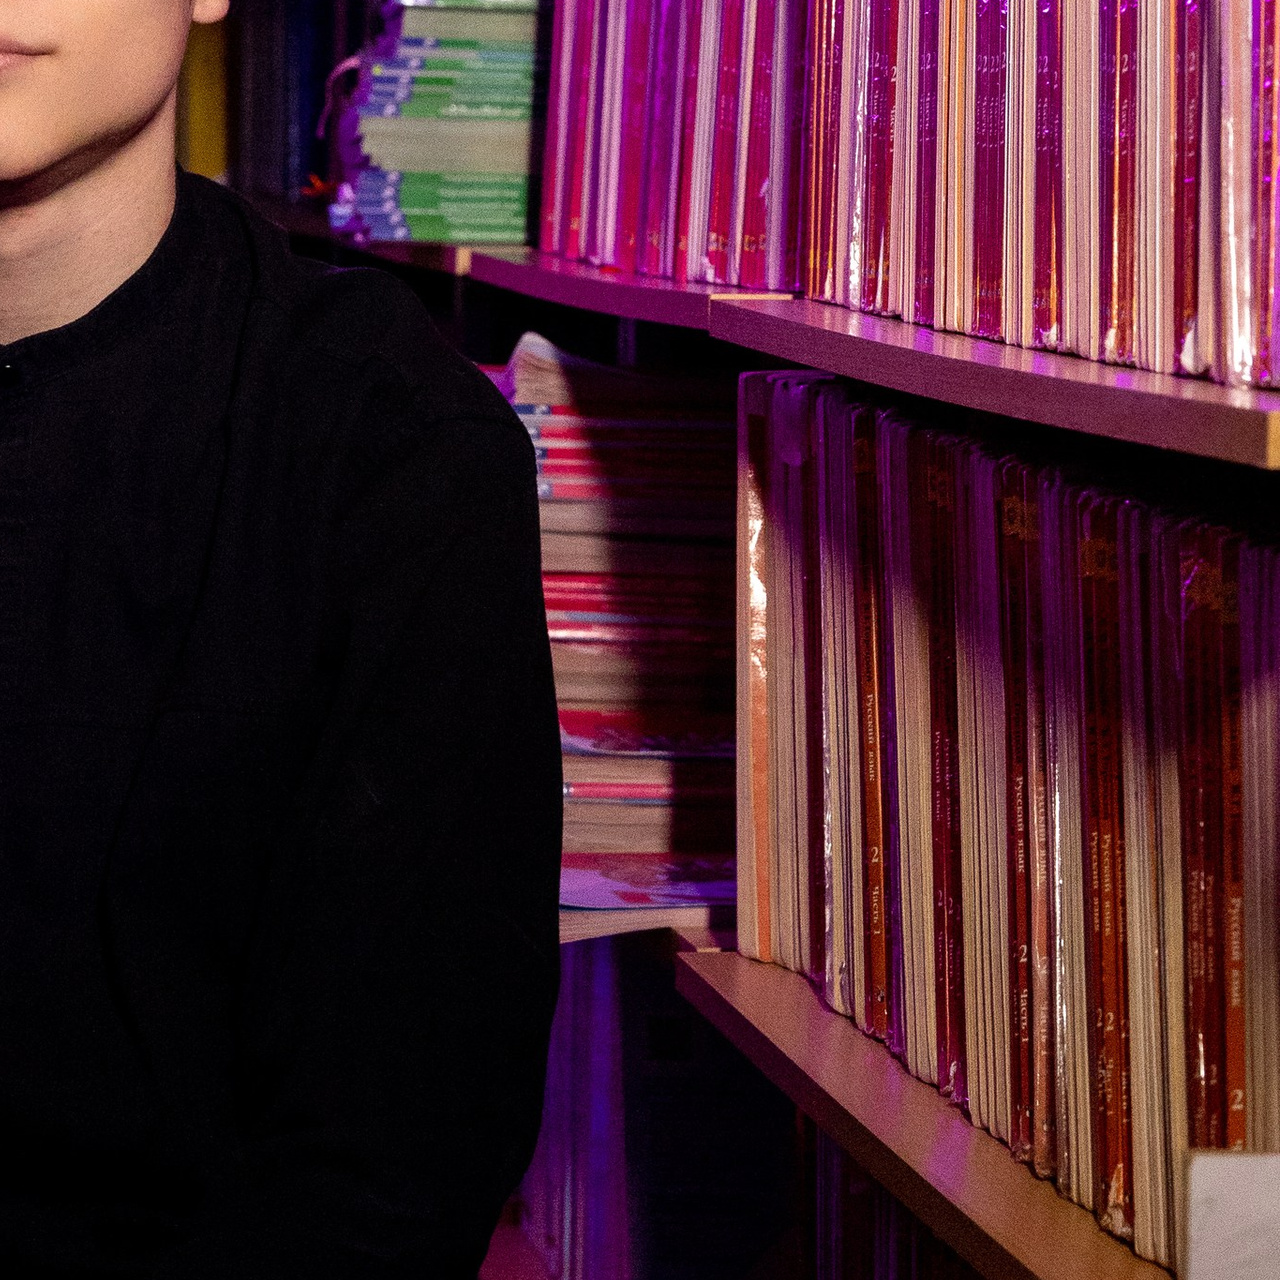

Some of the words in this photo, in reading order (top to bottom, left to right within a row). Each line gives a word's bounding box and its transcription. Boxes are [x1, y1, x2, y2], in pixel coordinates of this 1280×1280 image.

[890, 66, 897, 82] 2
[1121, 53, 1129, 74] 2
[867, 693, 876, 745] Русский
[868, 751, 876, 782] язык
[1014, 776, 1024, 832] Русский
[871, 846, 880, 864] 2
[1017, 839, 1025, 874] язык
[1090, 832, 1100, 889] Русский
[1102, 834, 1111, 893] Русский
[871, 885, 880, 924] Часть
[1093, 897, 1101, 933] язык
[1104, 900, 1112, 937] язык
[1206, 875, 1215, 938] Русский
[1228, 897, 1241, 961] Русский
[1018, 944, 1028, 963] 2
[1231, 969, 1241, 1008] язык
[1019, 988, 1029, 1030] Часть
[1096, 1008, 1103, 1028] 2
[1105, 1011, 1115, 1031] 2
[1230, 1089, 1244, 1111] 2
